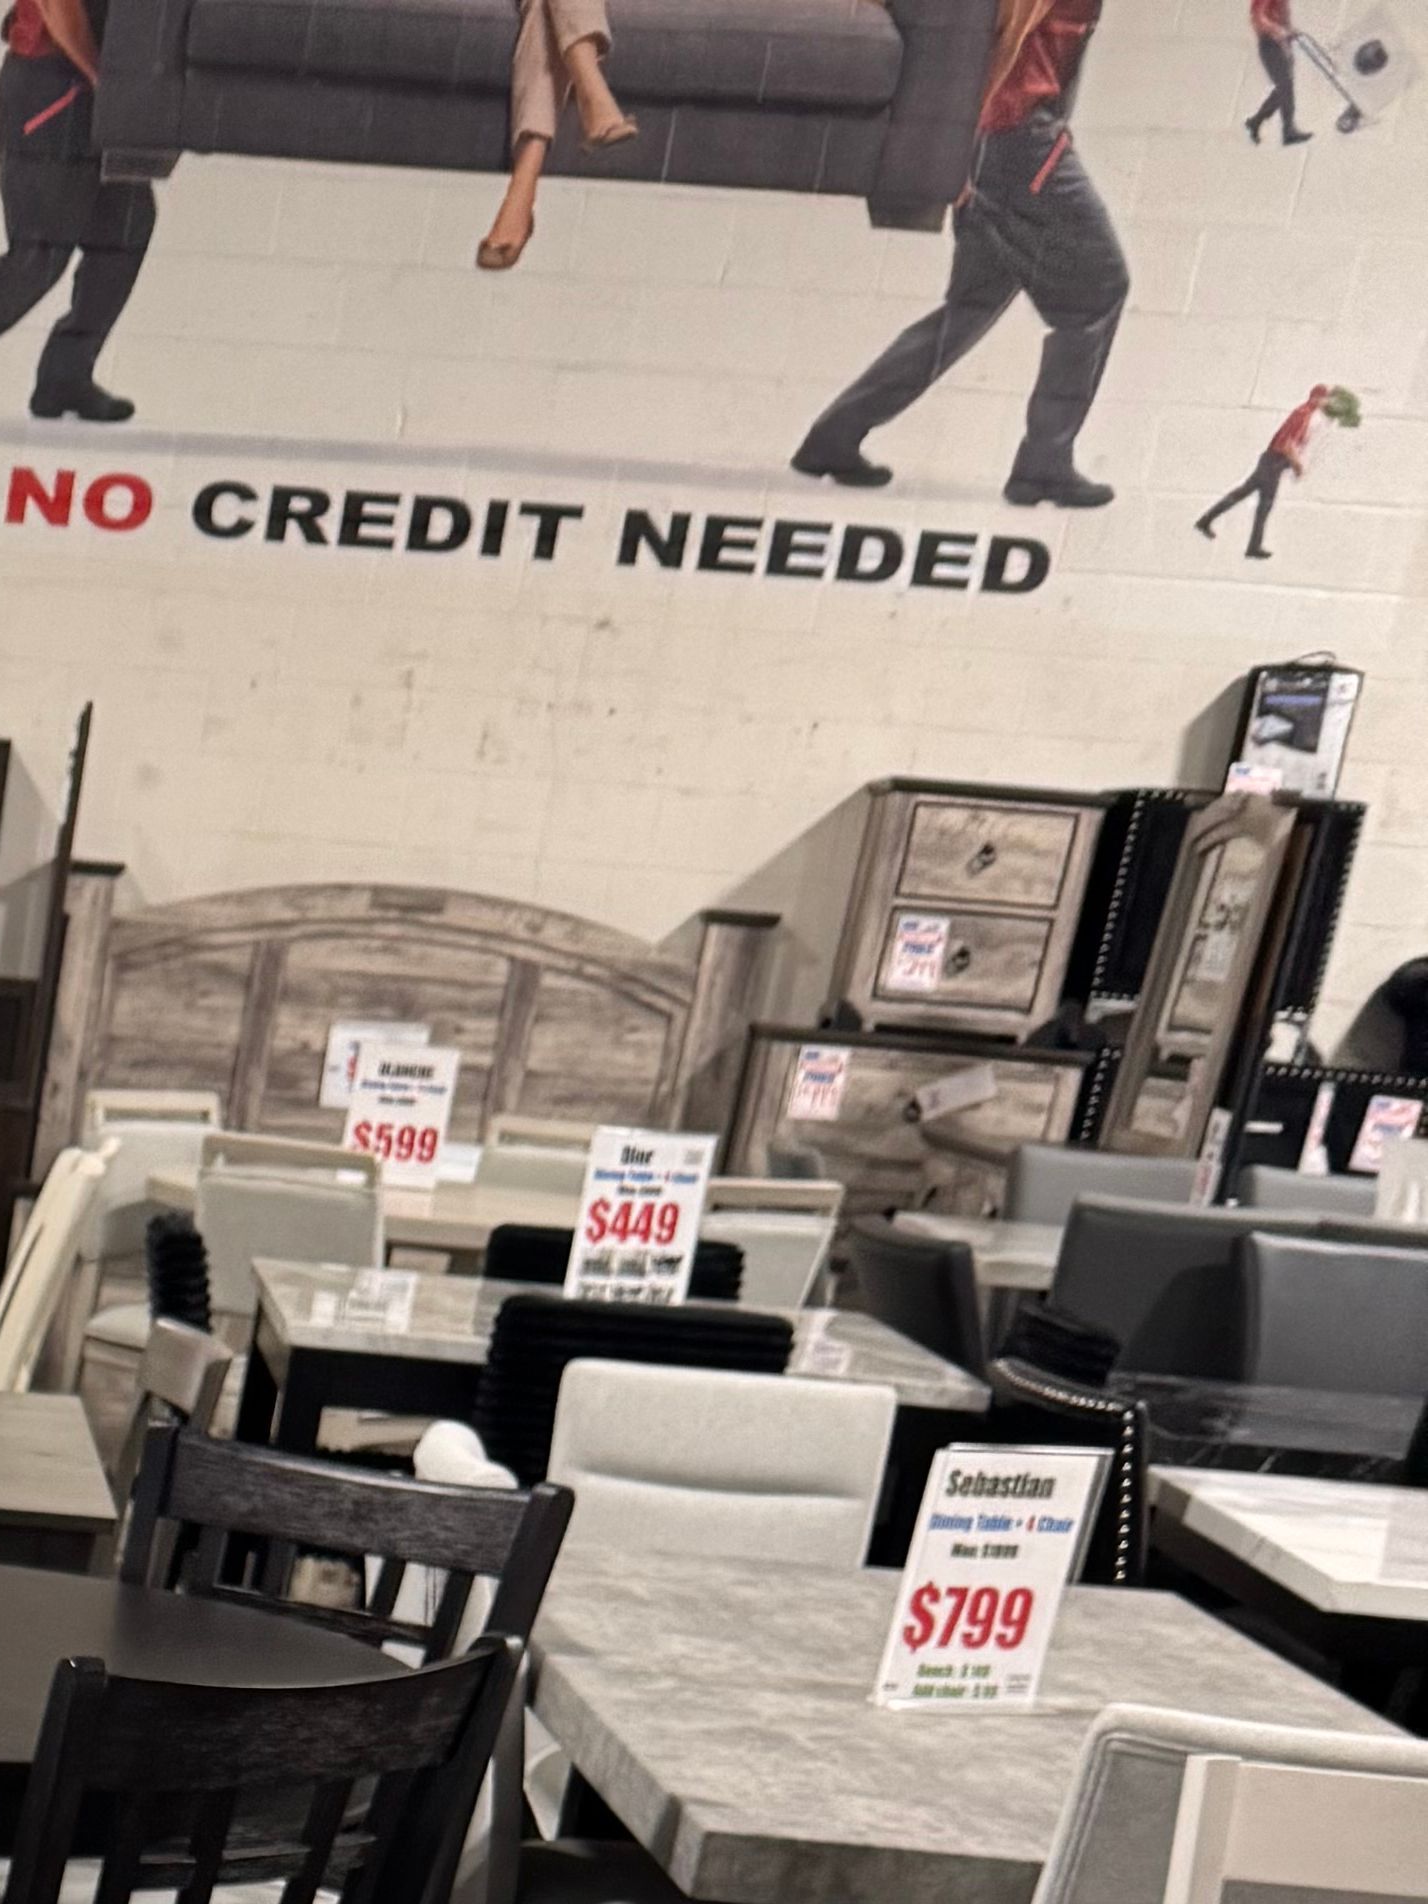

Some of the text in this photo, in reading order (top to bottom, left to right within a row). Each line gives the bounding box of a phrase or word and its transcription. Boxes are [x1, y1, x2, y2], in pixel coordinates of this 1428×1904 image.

[3, 467, 1052, 596] NO CREDIT NEEDED
[585, 1196, 680, 1246] $449
[946, 1469, 1057, 1499] Sebastian
[902, 1580, 1034, 1655] $799
